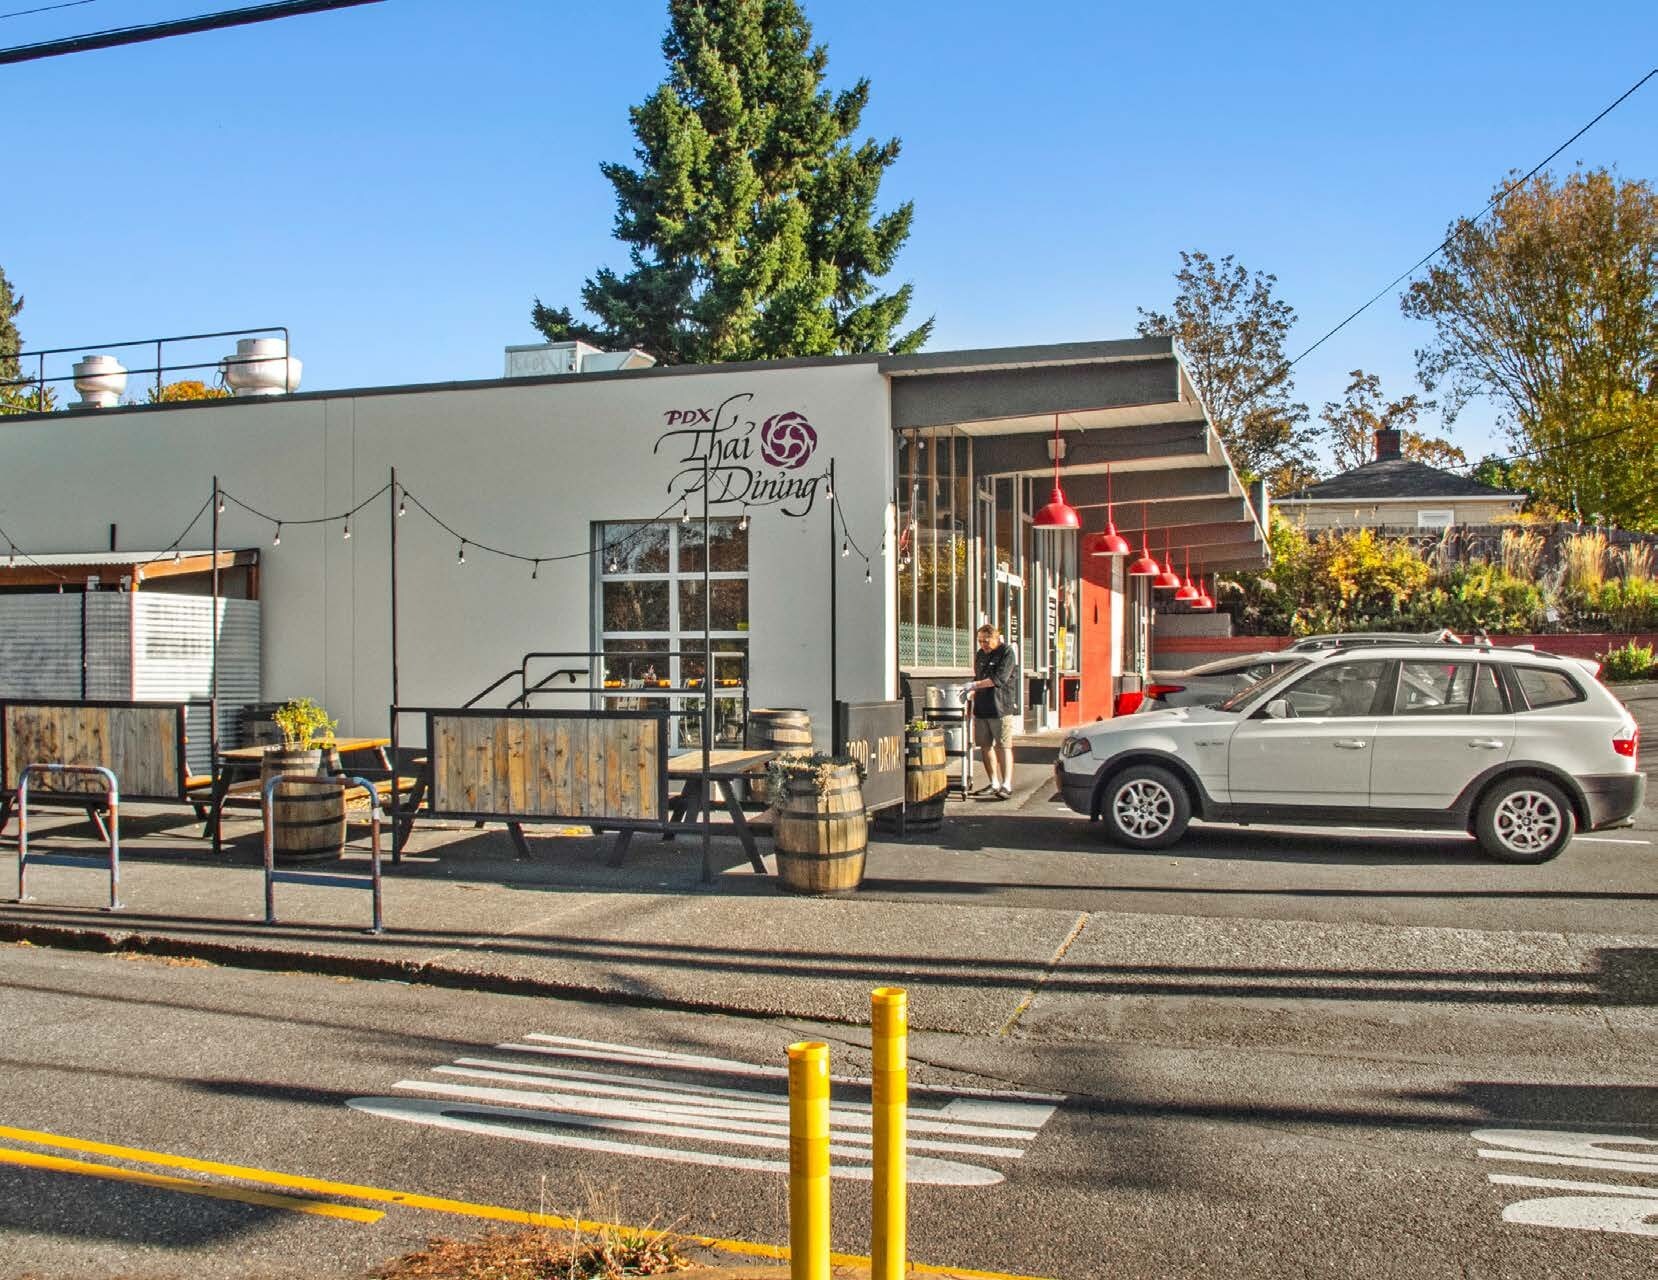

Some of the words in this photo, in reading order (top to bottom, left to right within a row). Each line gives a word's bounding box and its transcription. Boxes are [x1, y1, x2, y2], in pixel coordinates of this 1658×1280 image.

[653, 393, 756, 492] Thai
[664, 408, 713, 427] PDX
[667, 466, 823, 517] Dining
